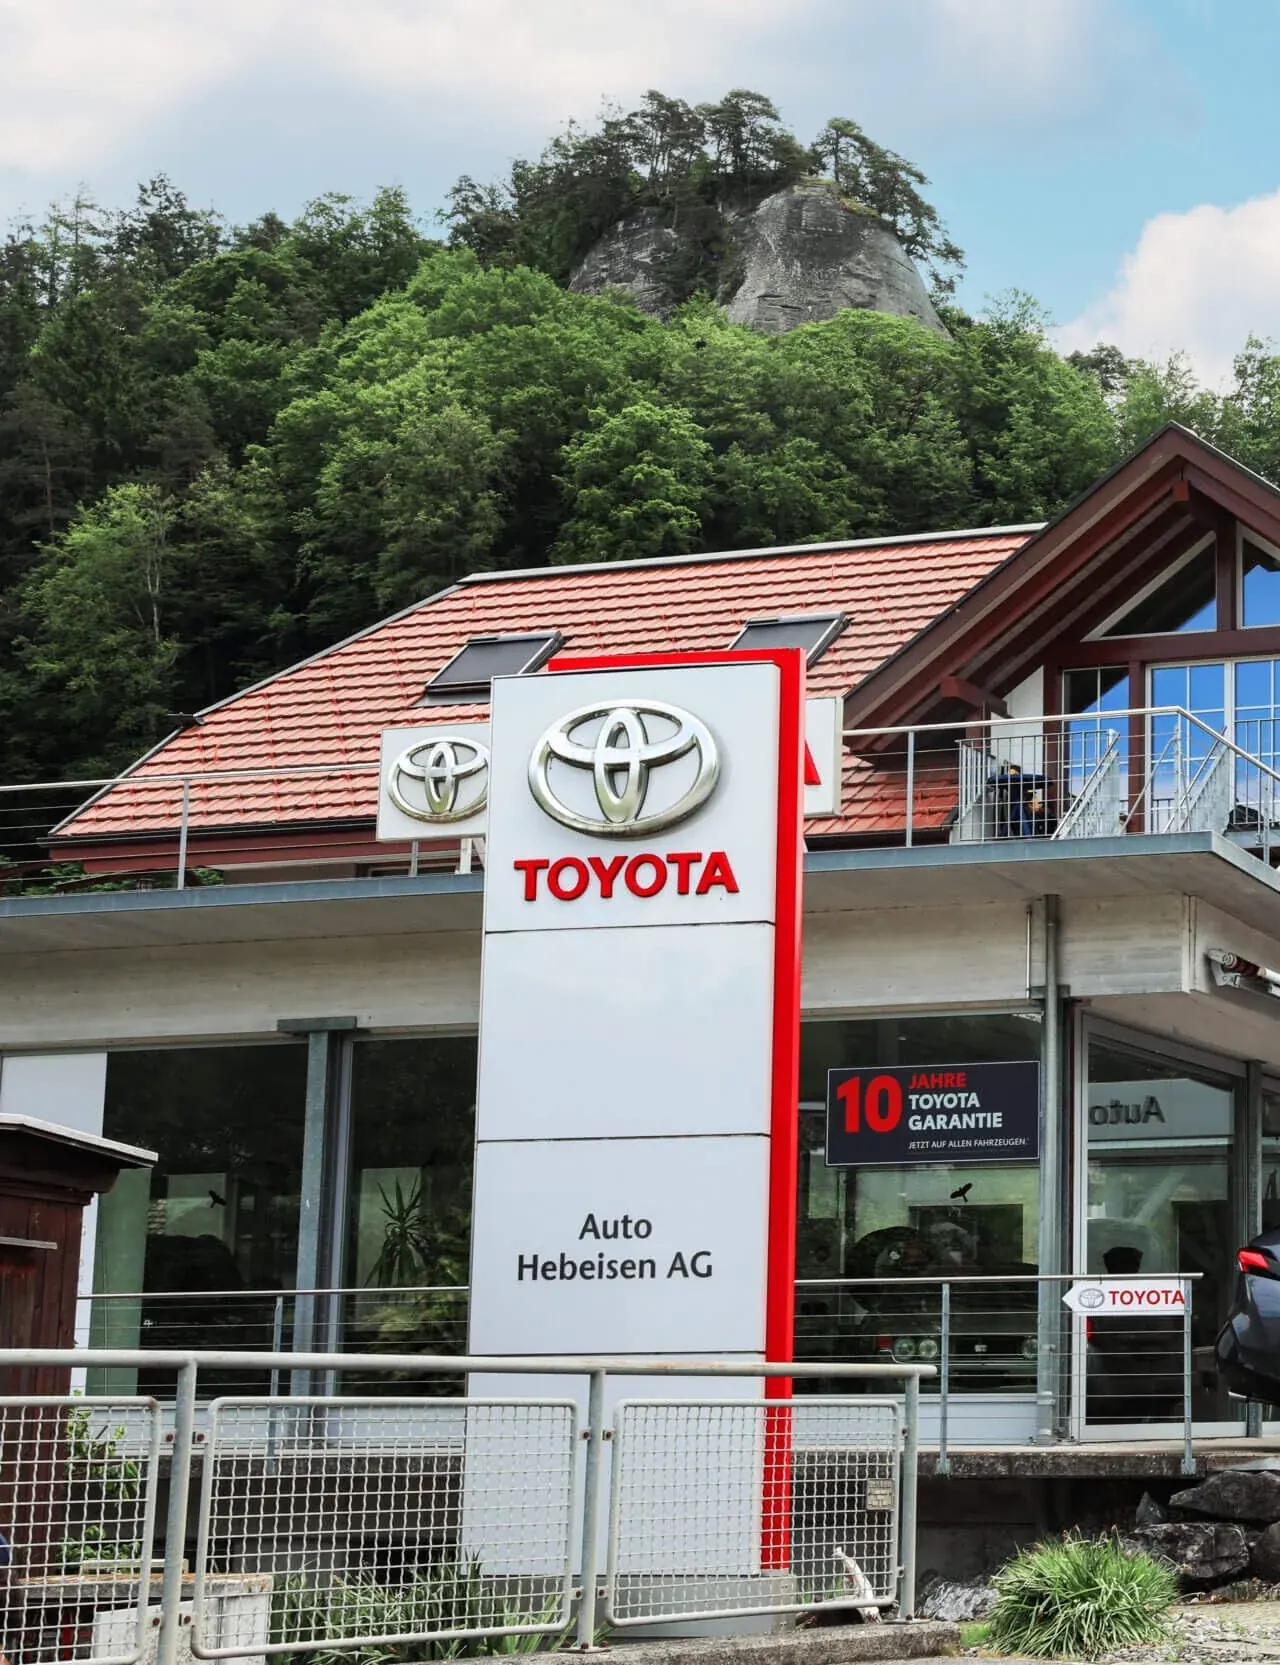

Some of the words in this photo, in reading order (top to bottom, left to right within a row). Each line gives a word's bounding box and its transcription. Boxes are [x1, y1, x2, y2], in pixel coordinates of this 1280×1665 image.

[514, 851, 739, 901] TOYOTA
[836, 1074, 903, 1134] 10
[908, 1071, 967, 1090] JAHRE
[908, 1092, 981, 1110] TOYOTA
[908, 1112, 1003, 1131] GARANTIE
[908, 1141, 930, 1150] JETZT
[931, 1140, 946, 1149] AUF
[948, 1139, 972, 1148] ALLEN
[578, 1213, 653, 1240] Auto
[517, 1252, 656, 1281] Hebeisen
[666, 1250, 713, 1279] AG
[1108, 1290, 1185, 1305] TOYOTA
